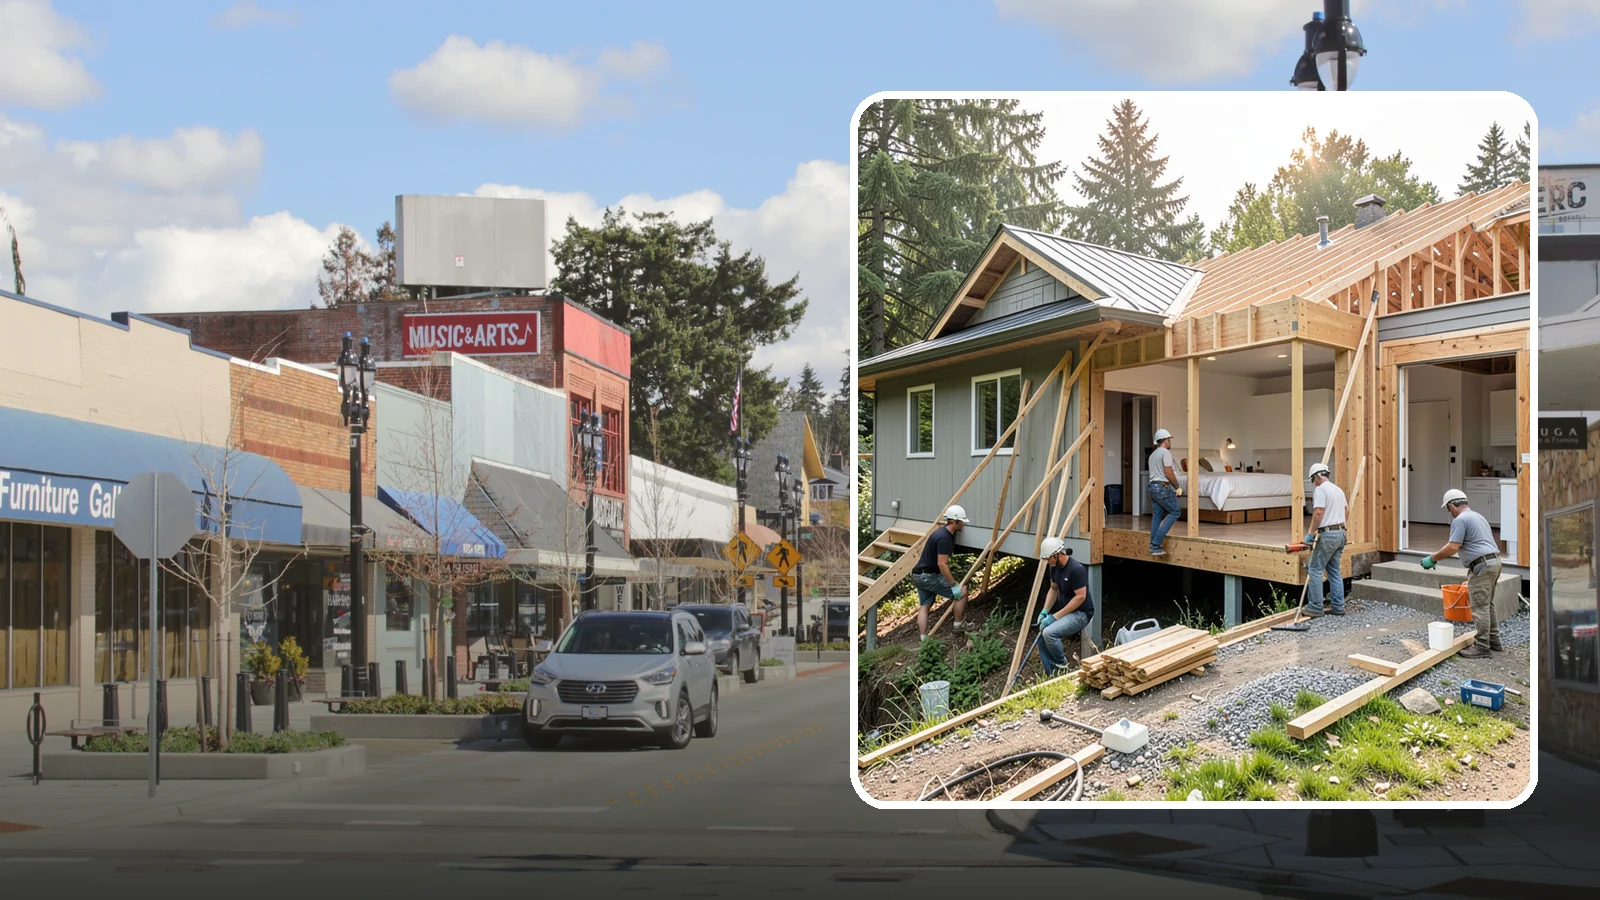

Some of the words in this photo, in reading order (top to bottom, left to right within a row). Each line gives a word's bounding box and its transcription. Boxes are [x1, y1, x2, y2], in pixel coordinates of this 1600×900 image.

[0, 471, 80, 515] Furniture
[89, 482, 122, 519] Gal
[453, 563, 479, 574] SUSHI
